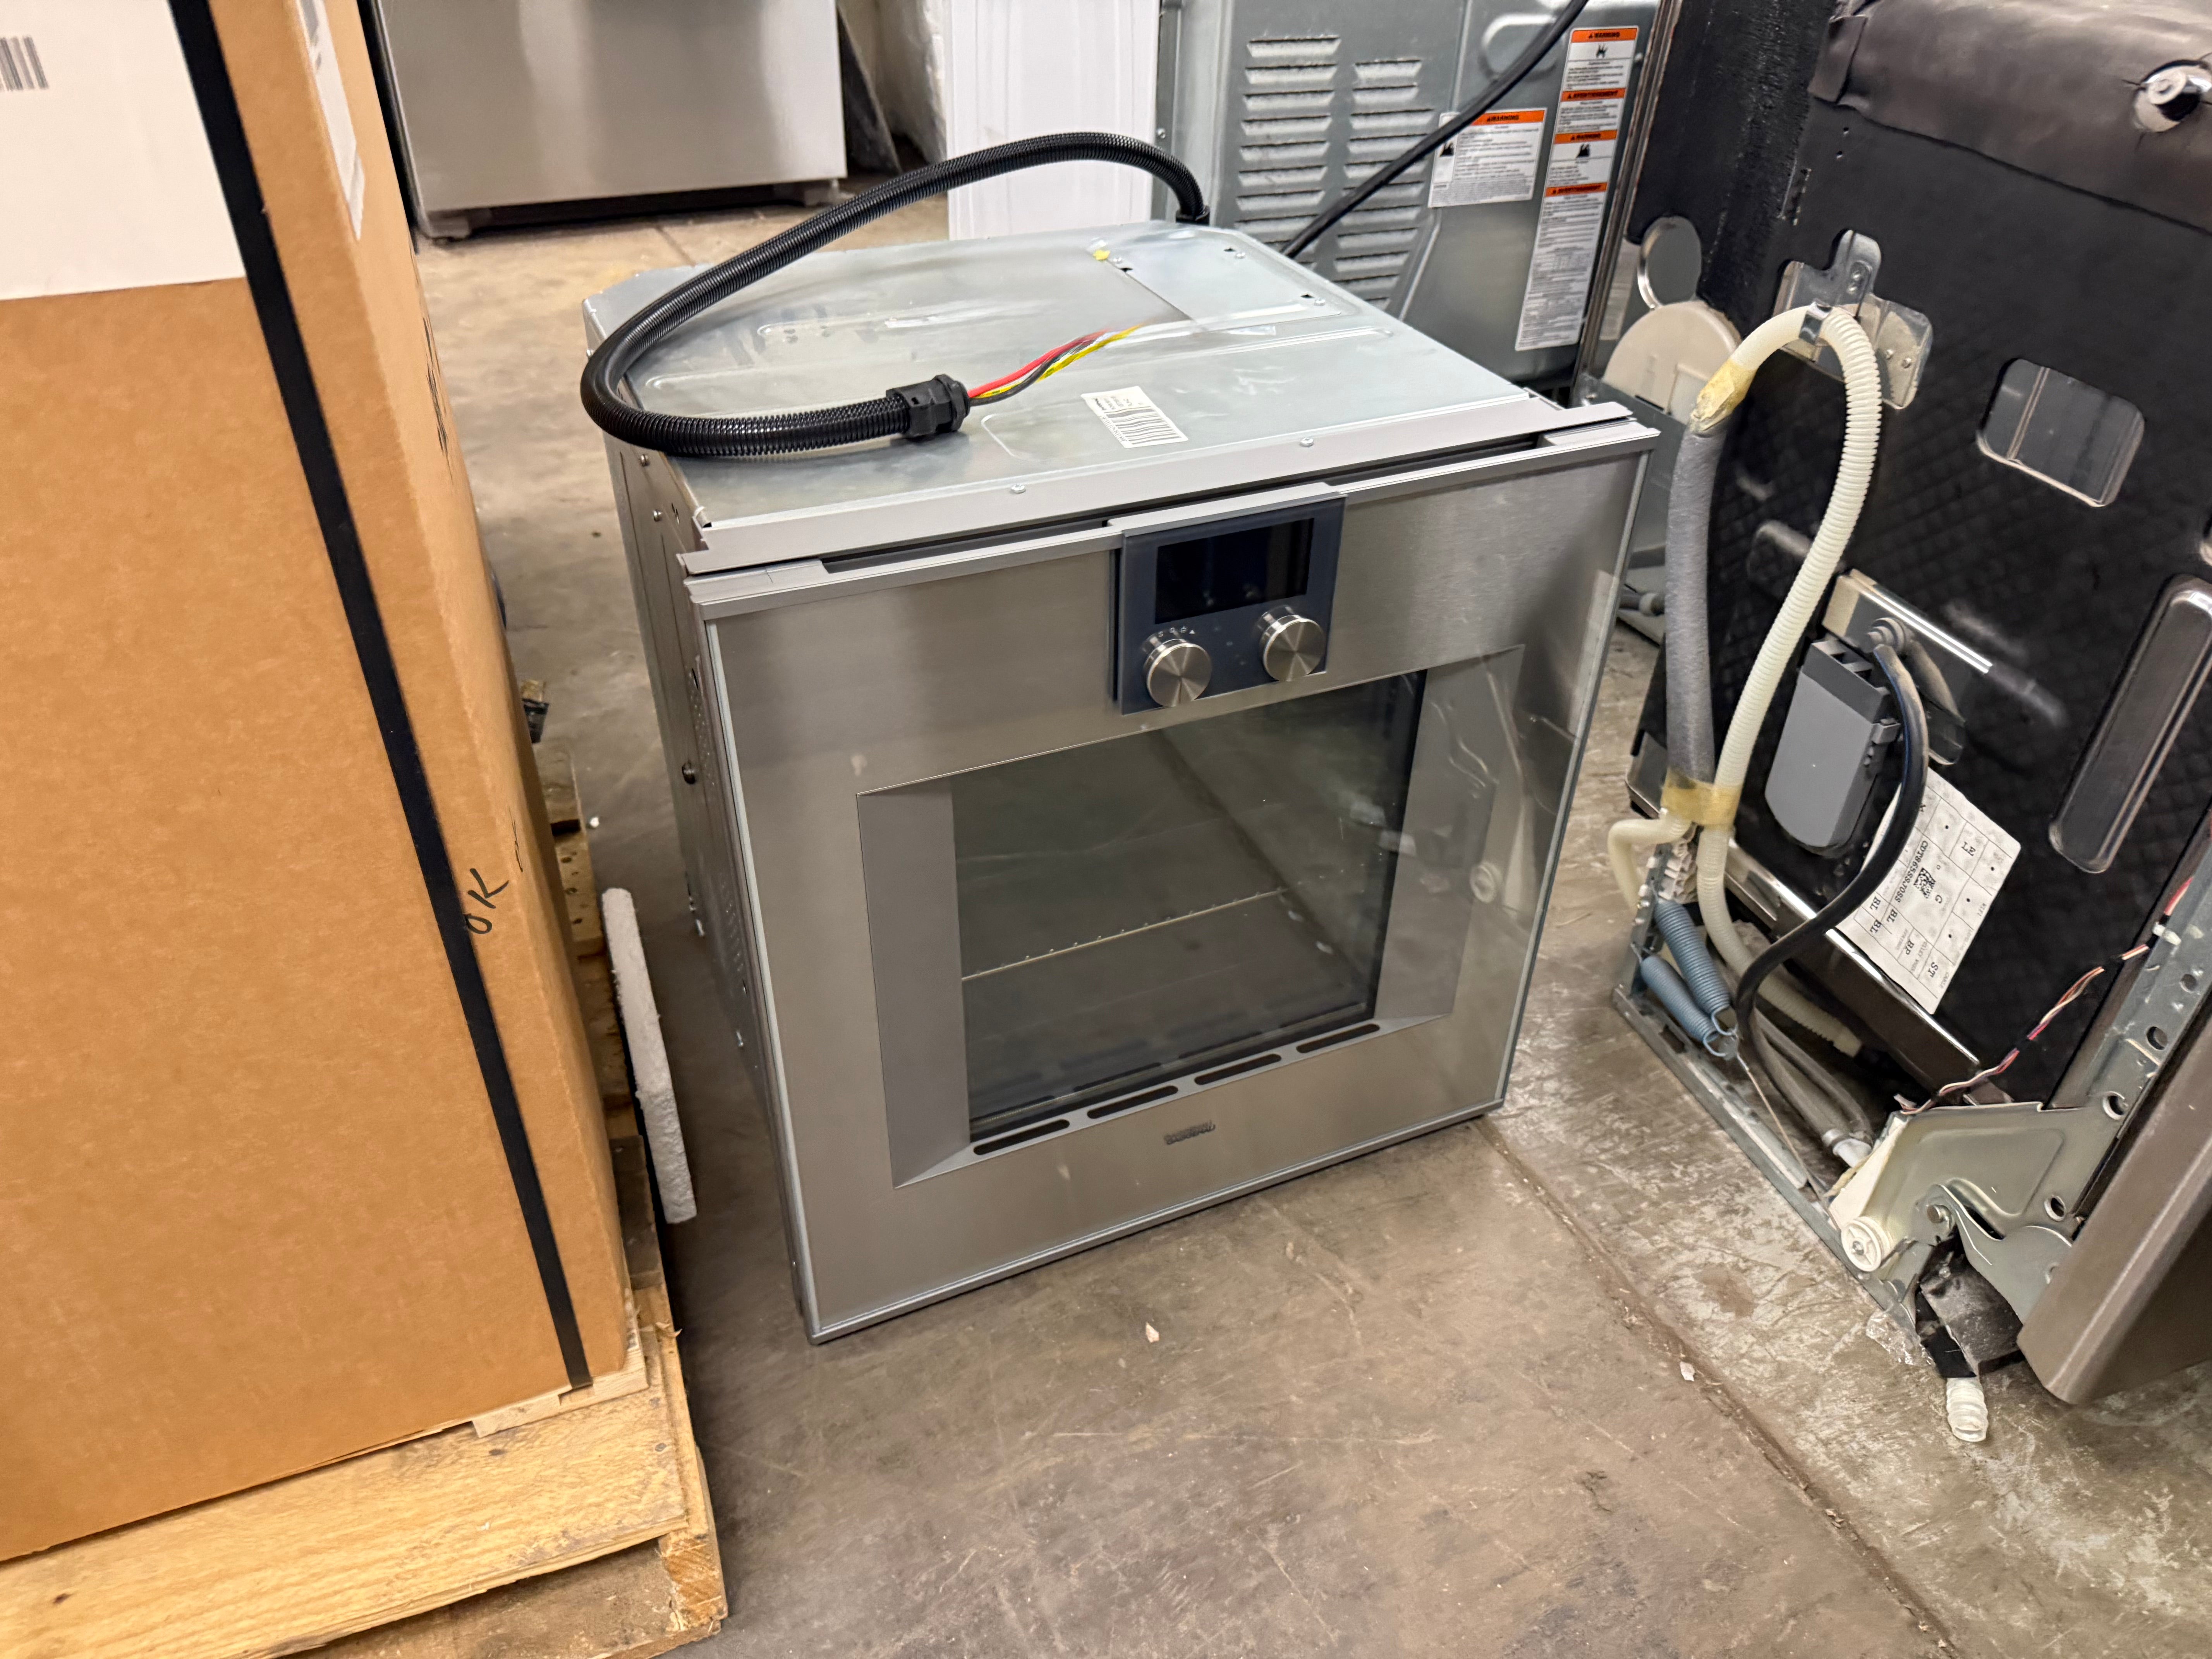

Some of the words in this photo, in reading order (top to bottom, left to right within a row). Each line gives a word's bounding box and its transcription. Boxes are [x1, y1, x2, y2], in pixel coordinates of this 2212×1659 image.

[1961, 841, 1976, 856] LE
[464, 868, 509, 934] OK
[1870, 896, 1881, 910] BL
[1935, 895, 1942, 903] G
[1886, 909, 1898, 922] BL
[1870, 919, 1882, 933] BL
[1906, 939, 1915, 955] BP
[1928, 962, 1939, 977] ST
